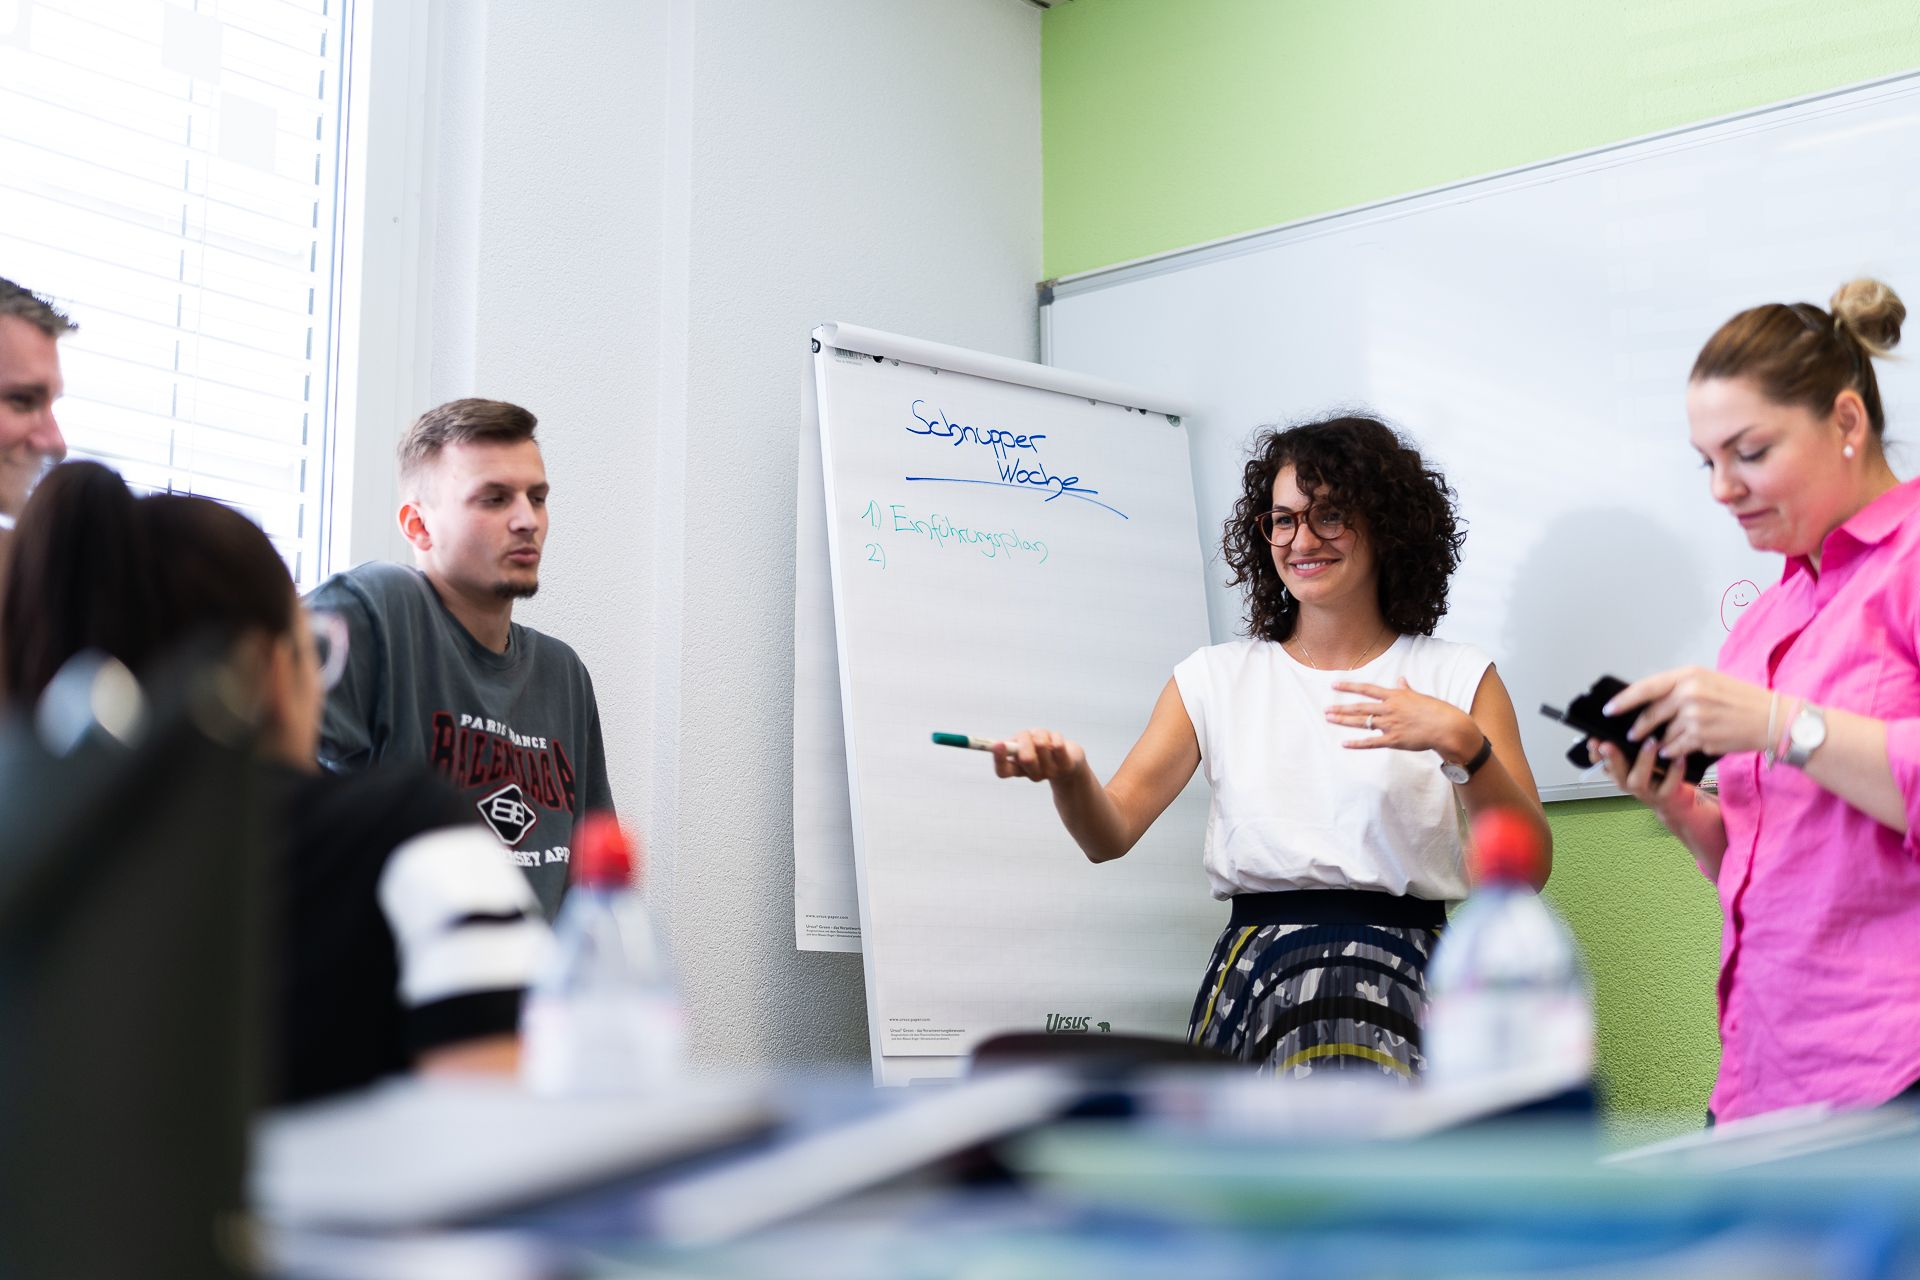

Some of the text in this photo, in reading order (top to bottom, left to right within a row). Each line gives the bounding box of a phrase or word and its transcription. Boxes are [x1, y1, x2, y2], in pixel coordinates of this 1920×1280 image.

[905, 399, 1047, 460] Schnupper
[996, 457, 1099, 502] Woche
[865, 542, 887, 570] 2)
[460, 713, 507, 736] PARIS
